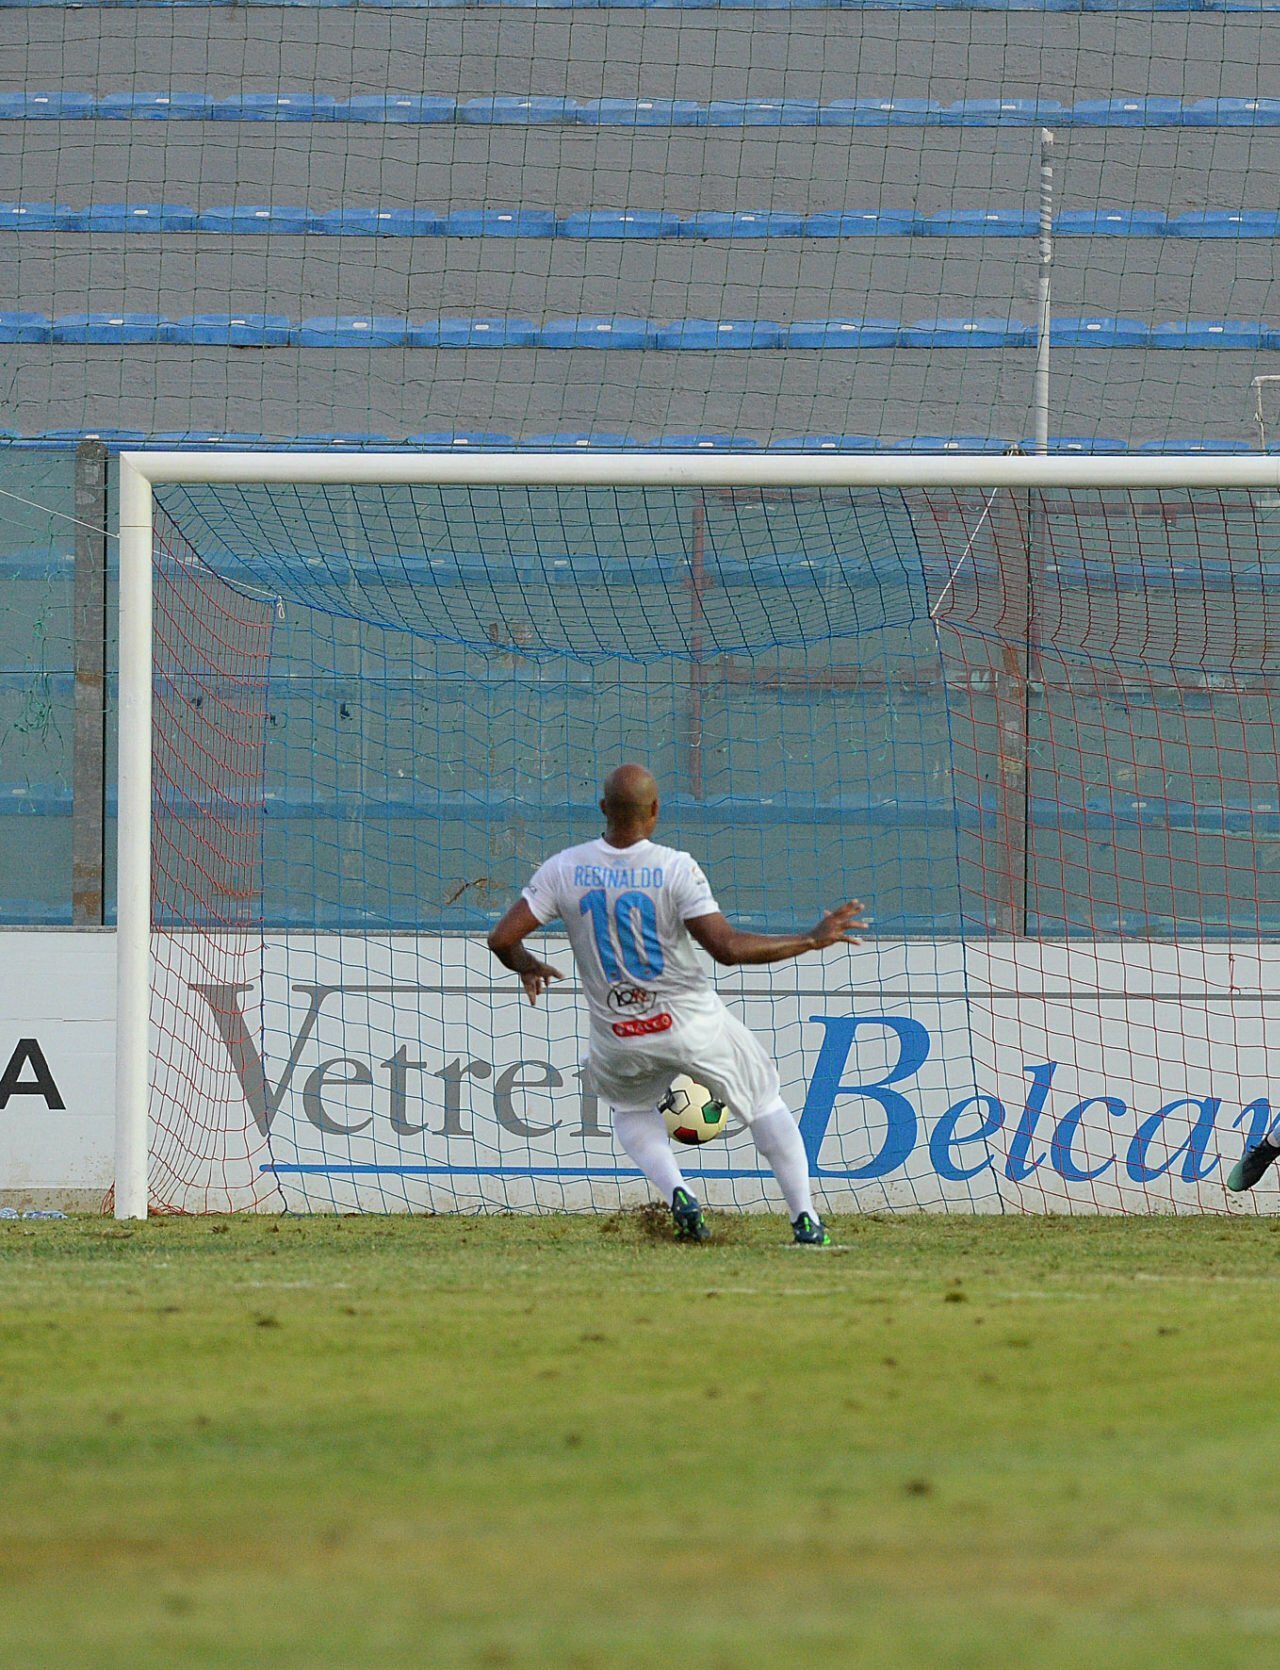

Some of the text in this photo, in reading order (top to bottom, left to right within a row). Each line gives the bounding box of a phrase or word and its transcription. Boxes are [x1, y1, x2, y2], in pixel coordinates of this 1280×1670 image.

[574, 865, 663, 889] REGINALDO
[579, 889, 664, 983] 10
[0, 1038, 66, 1110] A
